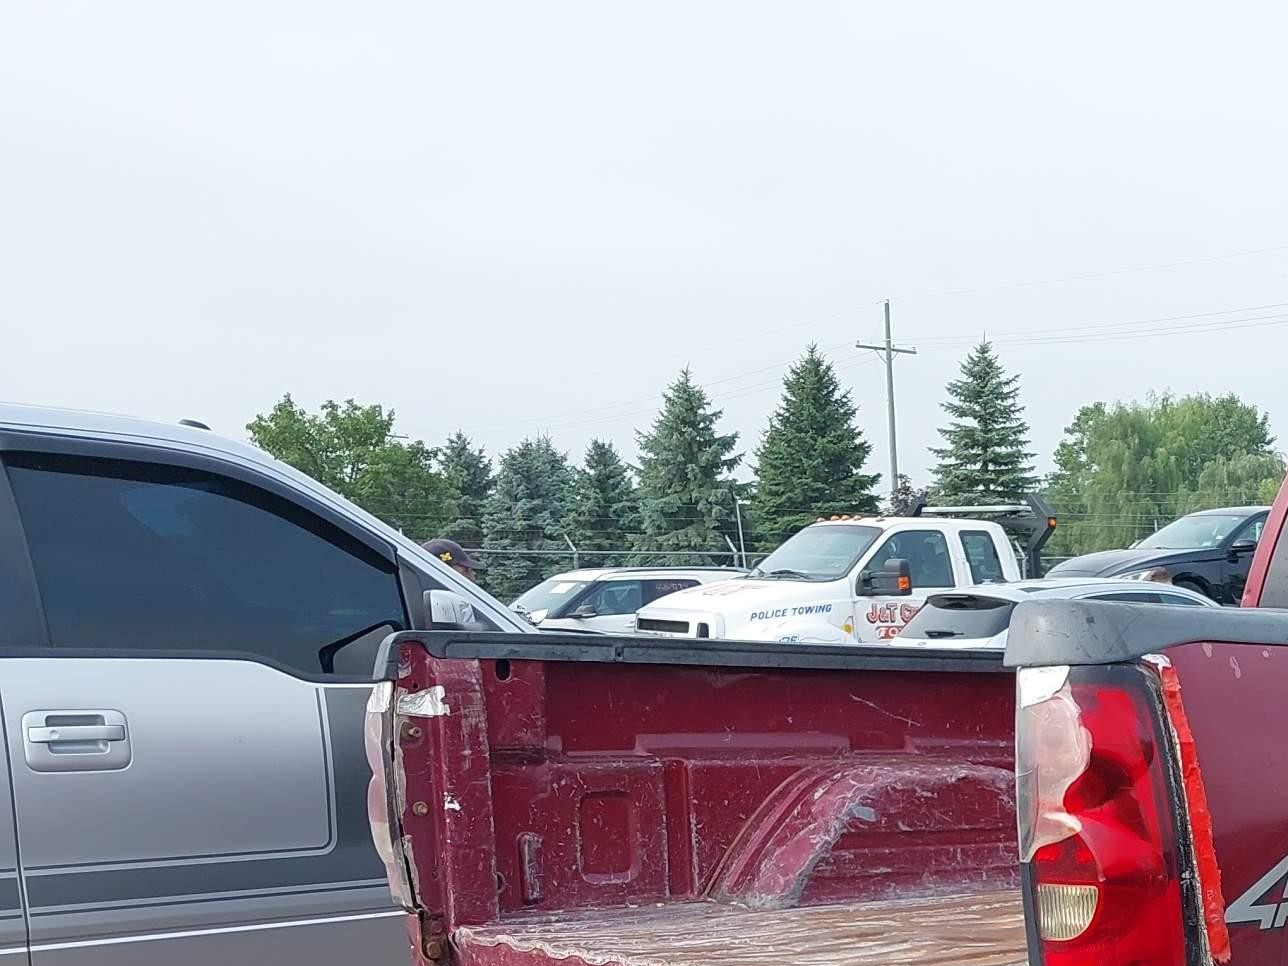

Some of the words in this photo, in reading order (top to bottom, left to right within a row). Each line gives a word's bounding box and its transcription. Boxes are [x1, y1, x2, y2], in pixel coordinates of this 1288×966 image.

[750, 608, 788, 621] POLICE
[791, 603, 832, 616] TOWING
[866, 603, 898, 623] J&T
